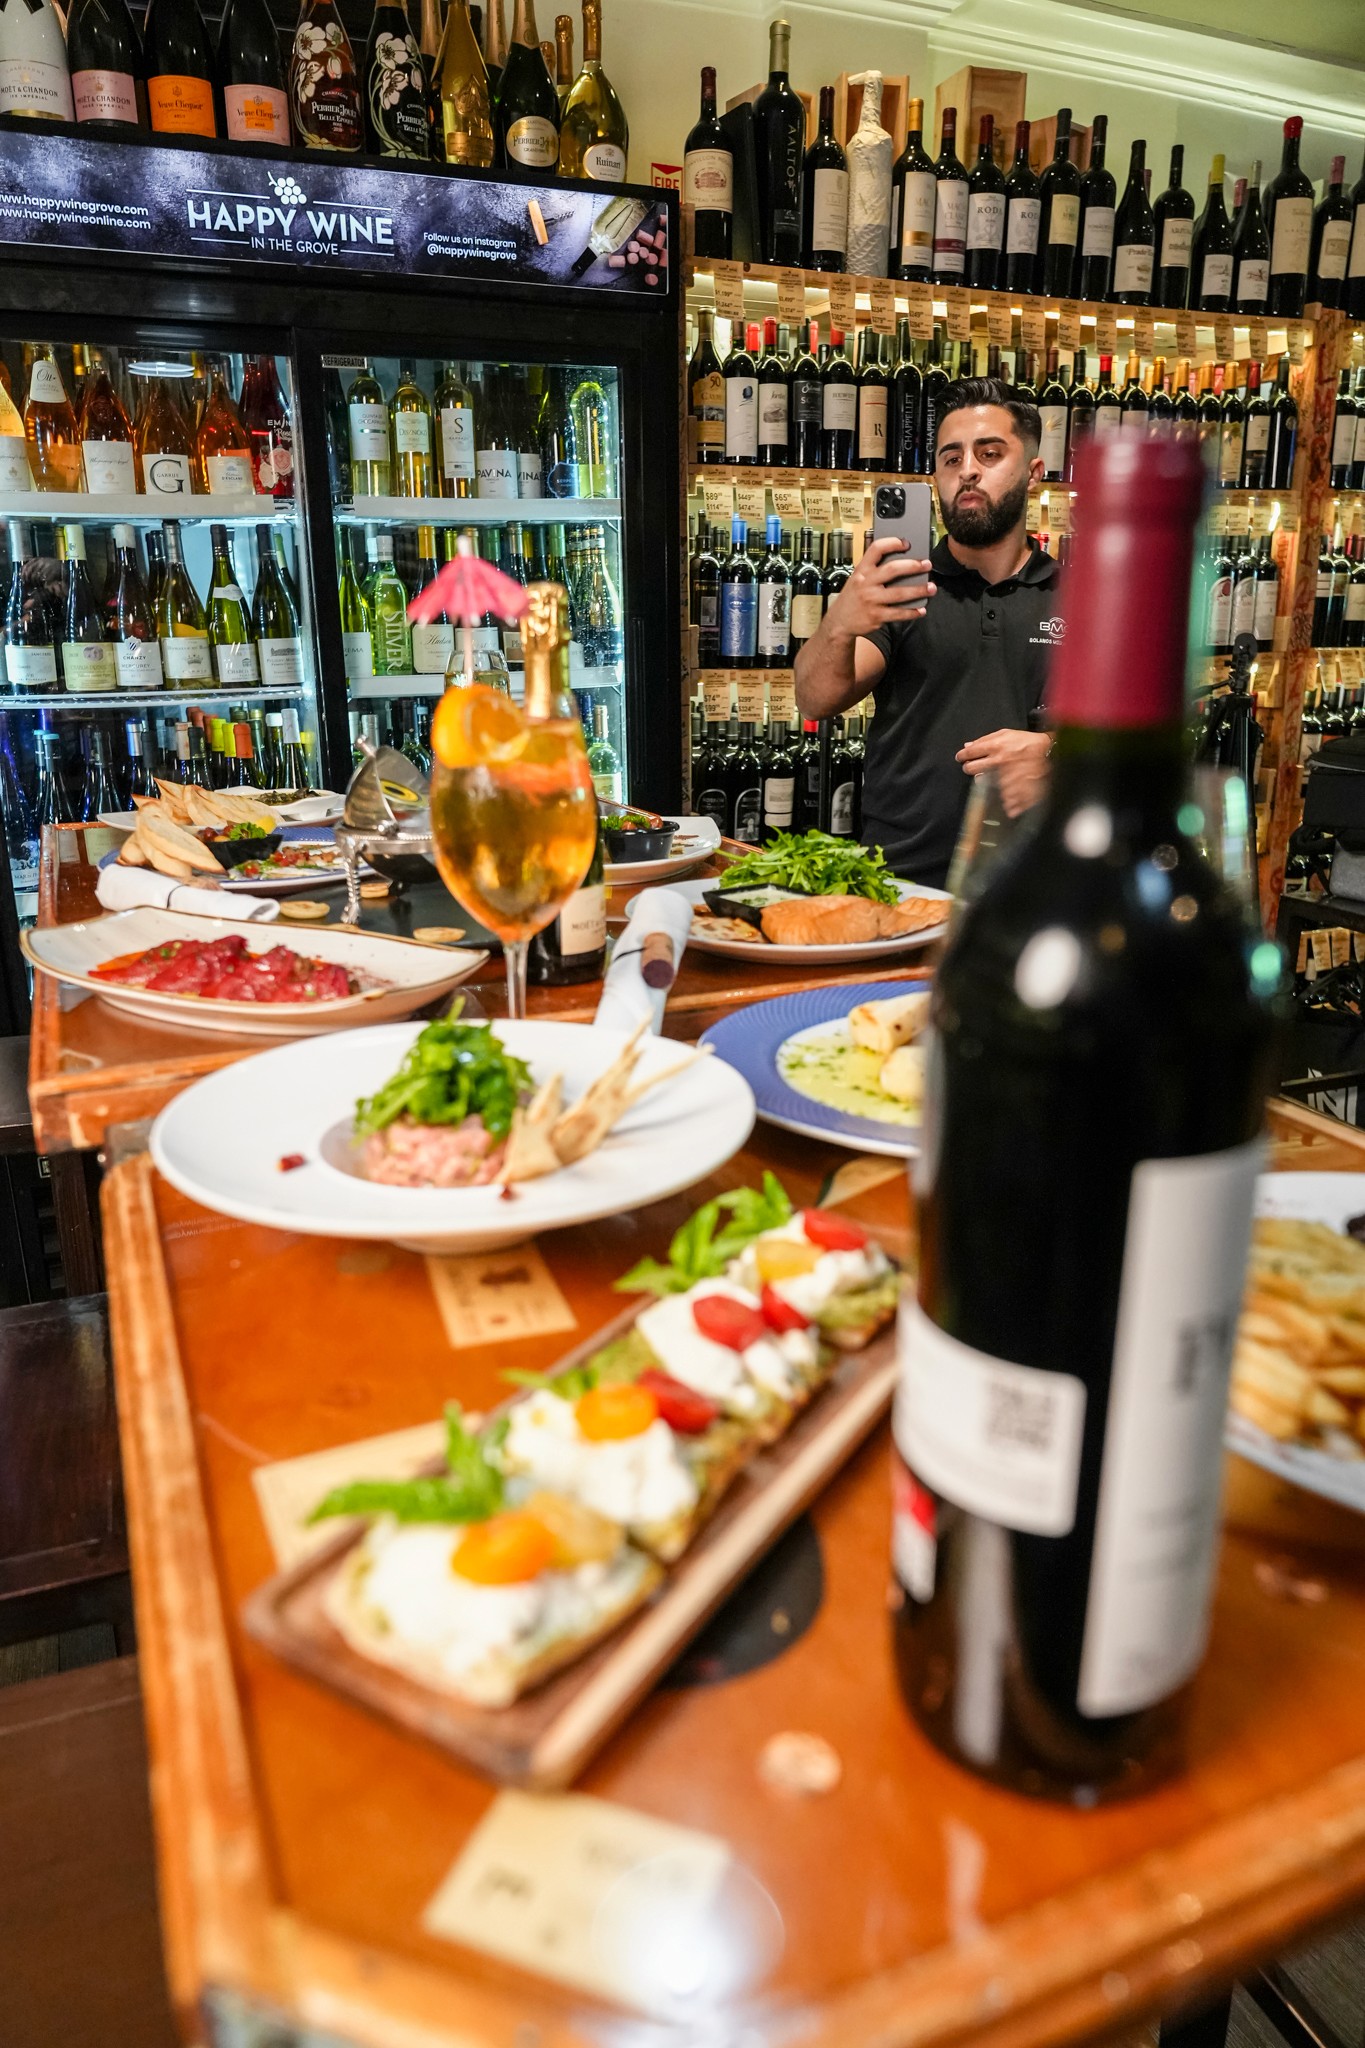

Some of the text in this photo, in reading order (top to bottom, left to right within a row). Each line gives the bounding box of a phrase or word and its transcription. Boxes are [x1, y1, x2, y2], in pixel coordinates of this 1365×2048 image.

[22, 86, 59, 98] CHANDON
[96, 95, 132, 106] CHANDON
[158, 100, 204, 110] Veuve Clicquot
[237, 108, 280, 120] Veuve Clicquot
[786, 124, 797, 178] AALTO
[596, 156, 621, 169] Ruinart
[654, 176, 680, 189] FIRE
[0, 194, 149, 216] ww.happywinegrove.com
[0, 208, 152, 230] ww.happywineonline.com
[187, 200, 394, 245] HAPPY WINE
[251, 236, 339, 256] IN THE GROVE
[424, 232, 450, 242] Follow
[450, 236, 461, 244] us
[474, 236, 517, 249] instagram
[427, 243, 517, 261] @happywinegrove
[322, 357, 366, 368] REFRIGERATOR
[710, 376, 721, 388] 50
[454, 417, 464, 434] S
[904, 392, 914, 450] CHAPPELLET
[926, 396, 936, 453] CHAPPELLET
[874, 423, 884, 438] R
[150, 458, 184, 494] G
[382, 610, 404, 676] SILVER
